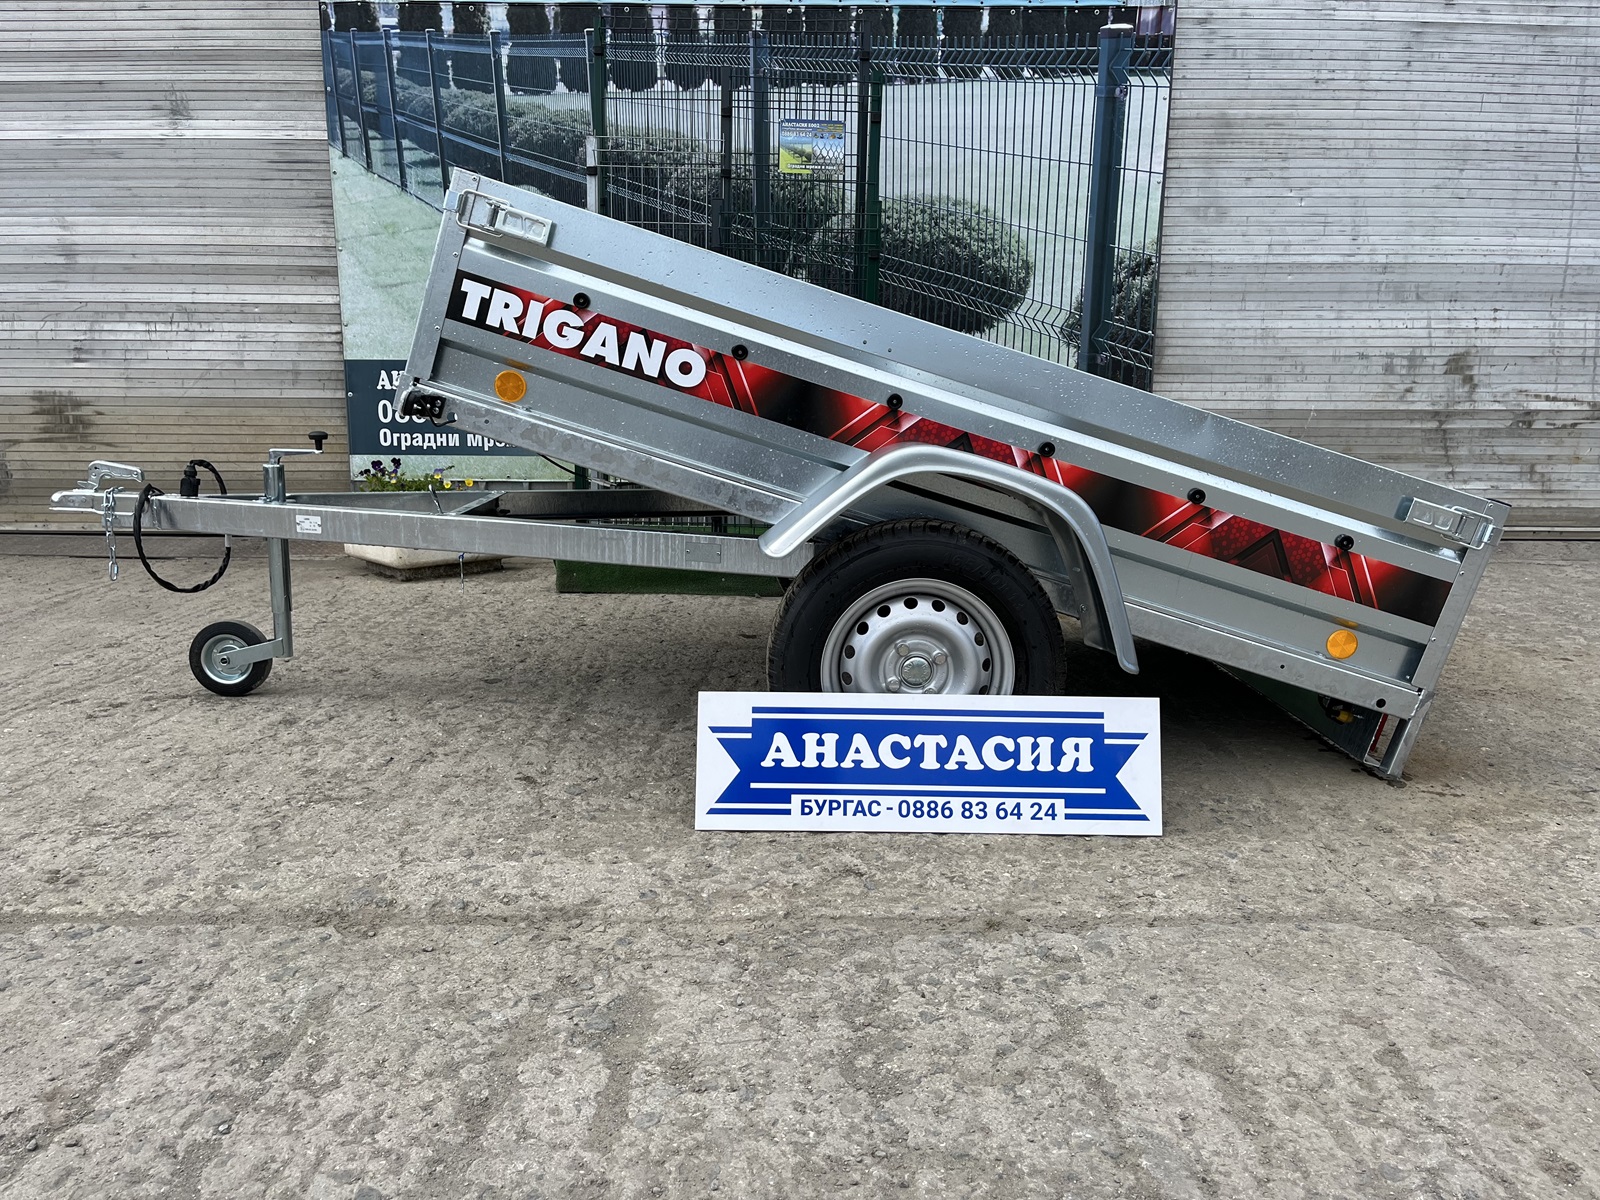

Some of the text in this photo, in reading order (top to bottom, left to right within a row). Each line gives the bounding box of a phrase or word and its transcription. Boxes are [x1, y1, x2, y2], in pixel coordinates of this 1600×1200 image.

[461, 278, 706, 388] TRIGANO
[379, 428, 460, 450] Оградни
[760, 732, 1094, 773] АНАСТАСИЯ
[800, 799, 882, 817] БУРГАС
[897, 800, 954, 819] 0886
[961, 801, 989, 820] 83
[996, 802, 1023, 821] 64
[1030, 802, 1058, 821] 24
